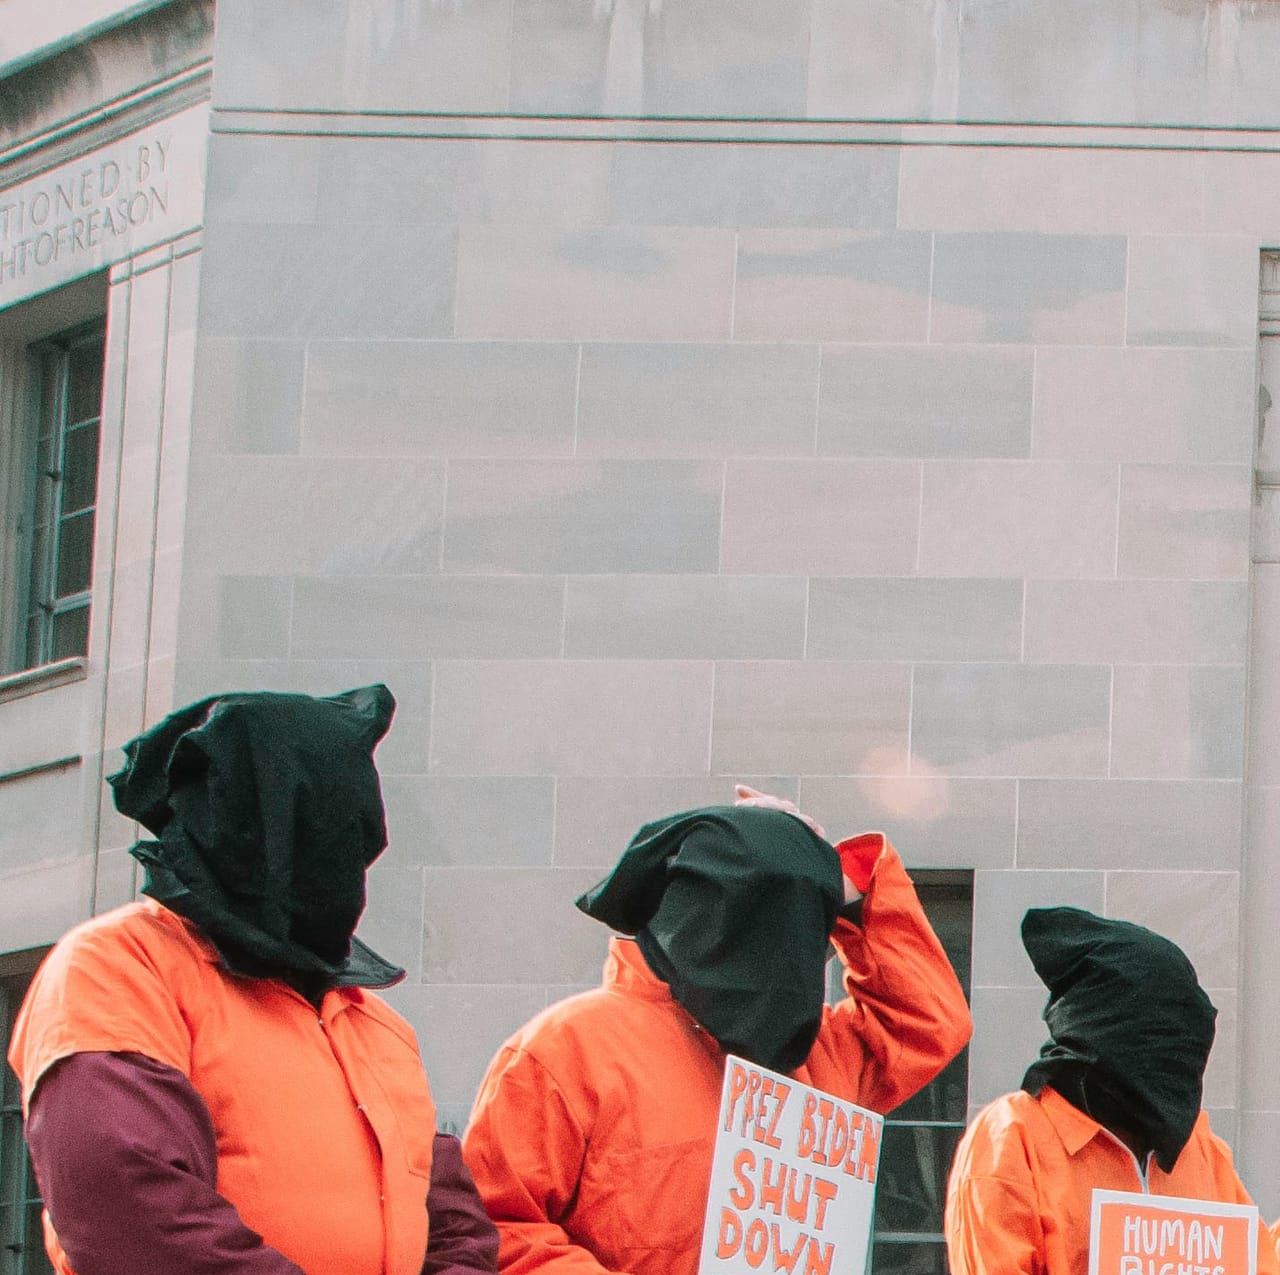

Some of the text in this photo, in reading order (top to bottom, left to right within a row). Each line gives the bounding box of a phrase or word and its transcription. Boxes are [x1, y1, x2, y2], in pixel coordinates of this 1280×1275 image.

[137, 138, 171, 183] BY
[34, 225, 68, 266] OF
[71, 185, 168, 254] REASON
[724, 1063, 882, 1184] PREZ BIDEN
[729, 1148, 839, 1231] SHUT
[1123, 1215, 1224, 1264] HUMAN
